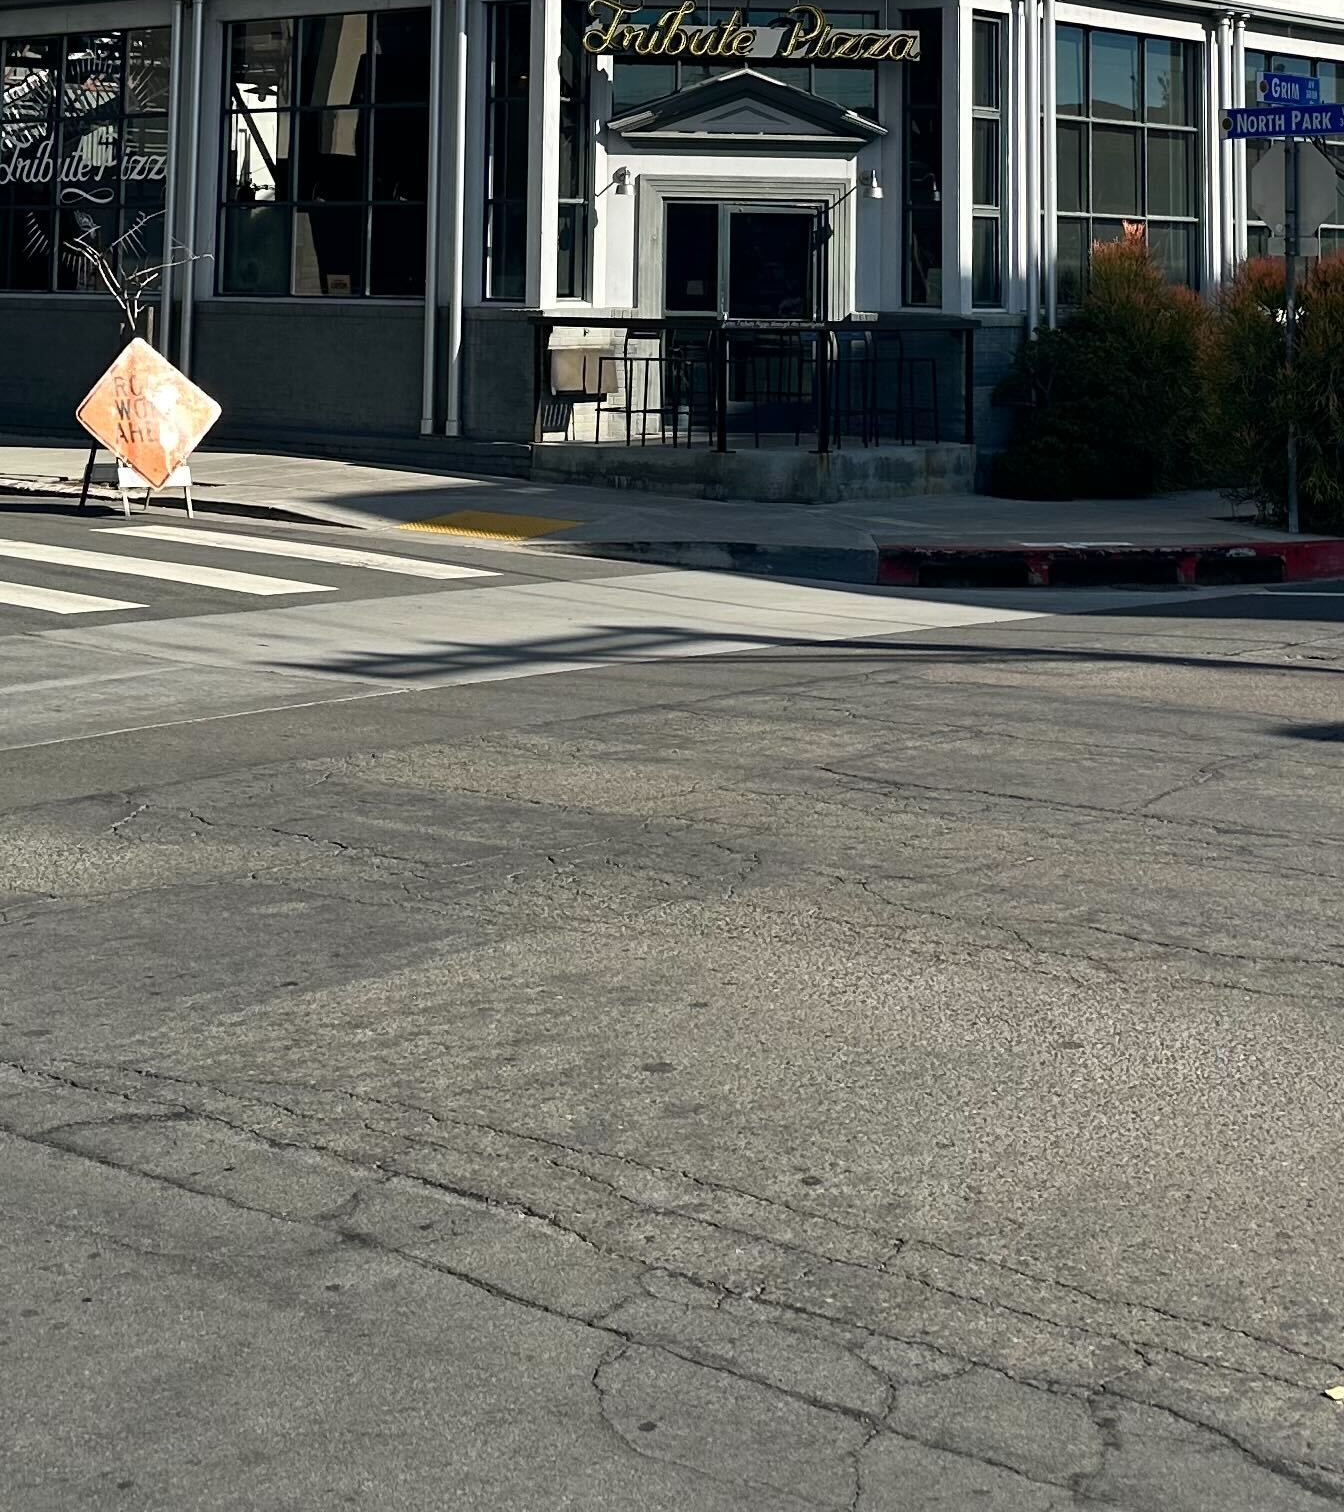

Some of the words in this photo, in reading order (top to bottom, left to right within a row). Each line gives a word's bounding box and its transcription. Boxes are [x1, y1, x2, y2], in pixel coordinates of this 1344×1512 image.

[779, 3, 921, 62] Pizza
[1236, 113, 1285, 134] NORTH
[1291, 110, 1332, 131] PARK
